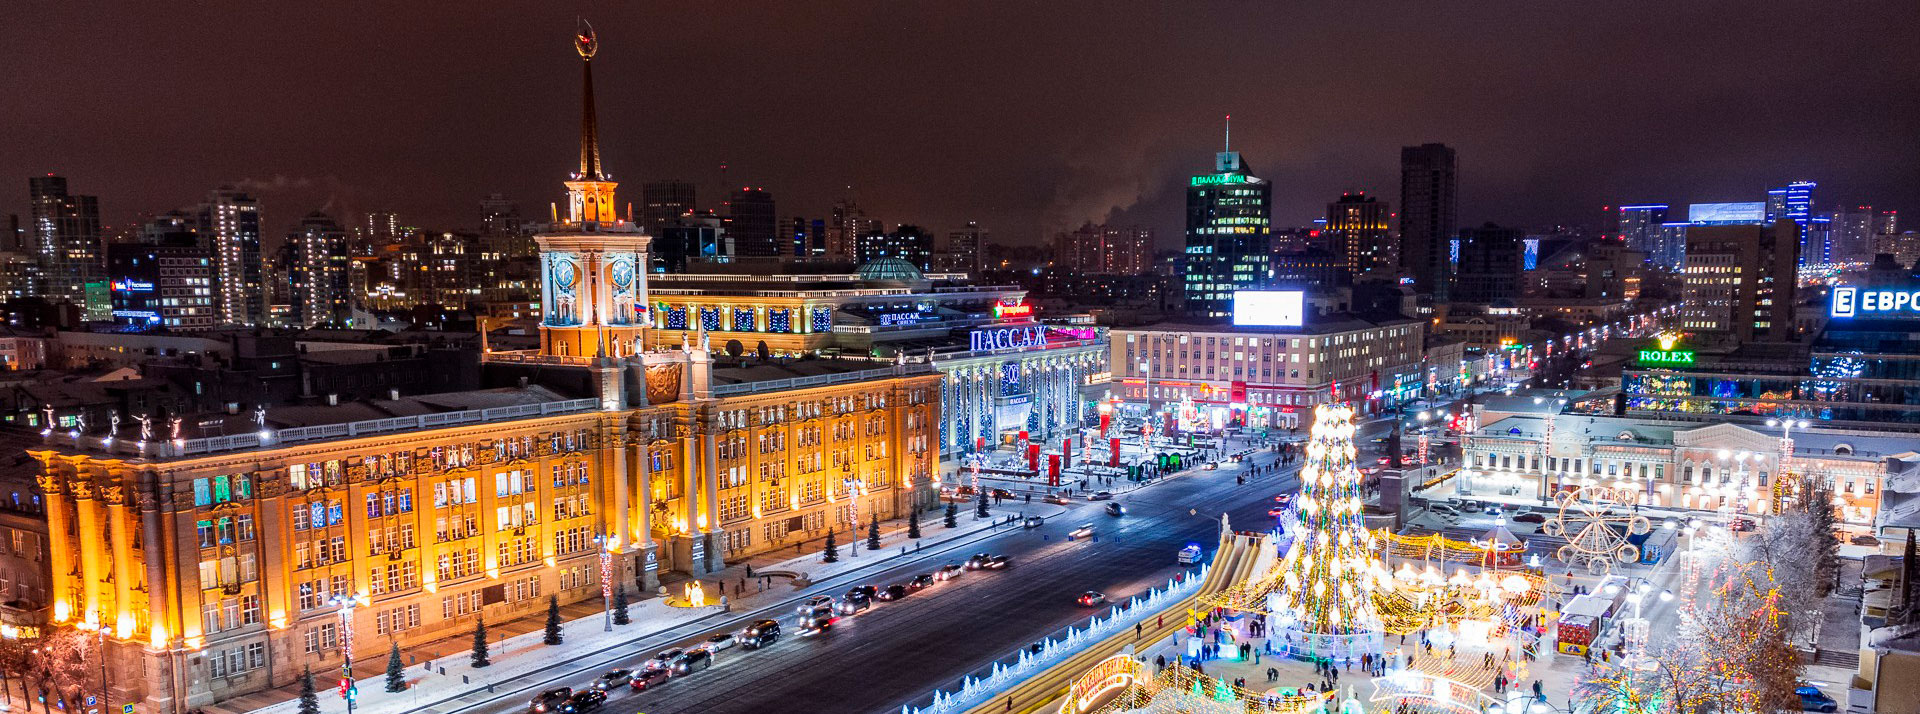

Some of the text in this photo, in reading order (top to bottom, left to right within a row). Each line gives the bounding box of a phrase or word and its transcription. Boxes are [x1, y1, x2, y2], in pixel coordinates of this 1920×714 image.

[891, 312, 920, 321] ПАССАЖ
[969, 325, 1048, 352] ПАССАЖ
[1639, 350, 1694, 362] ROLEX
